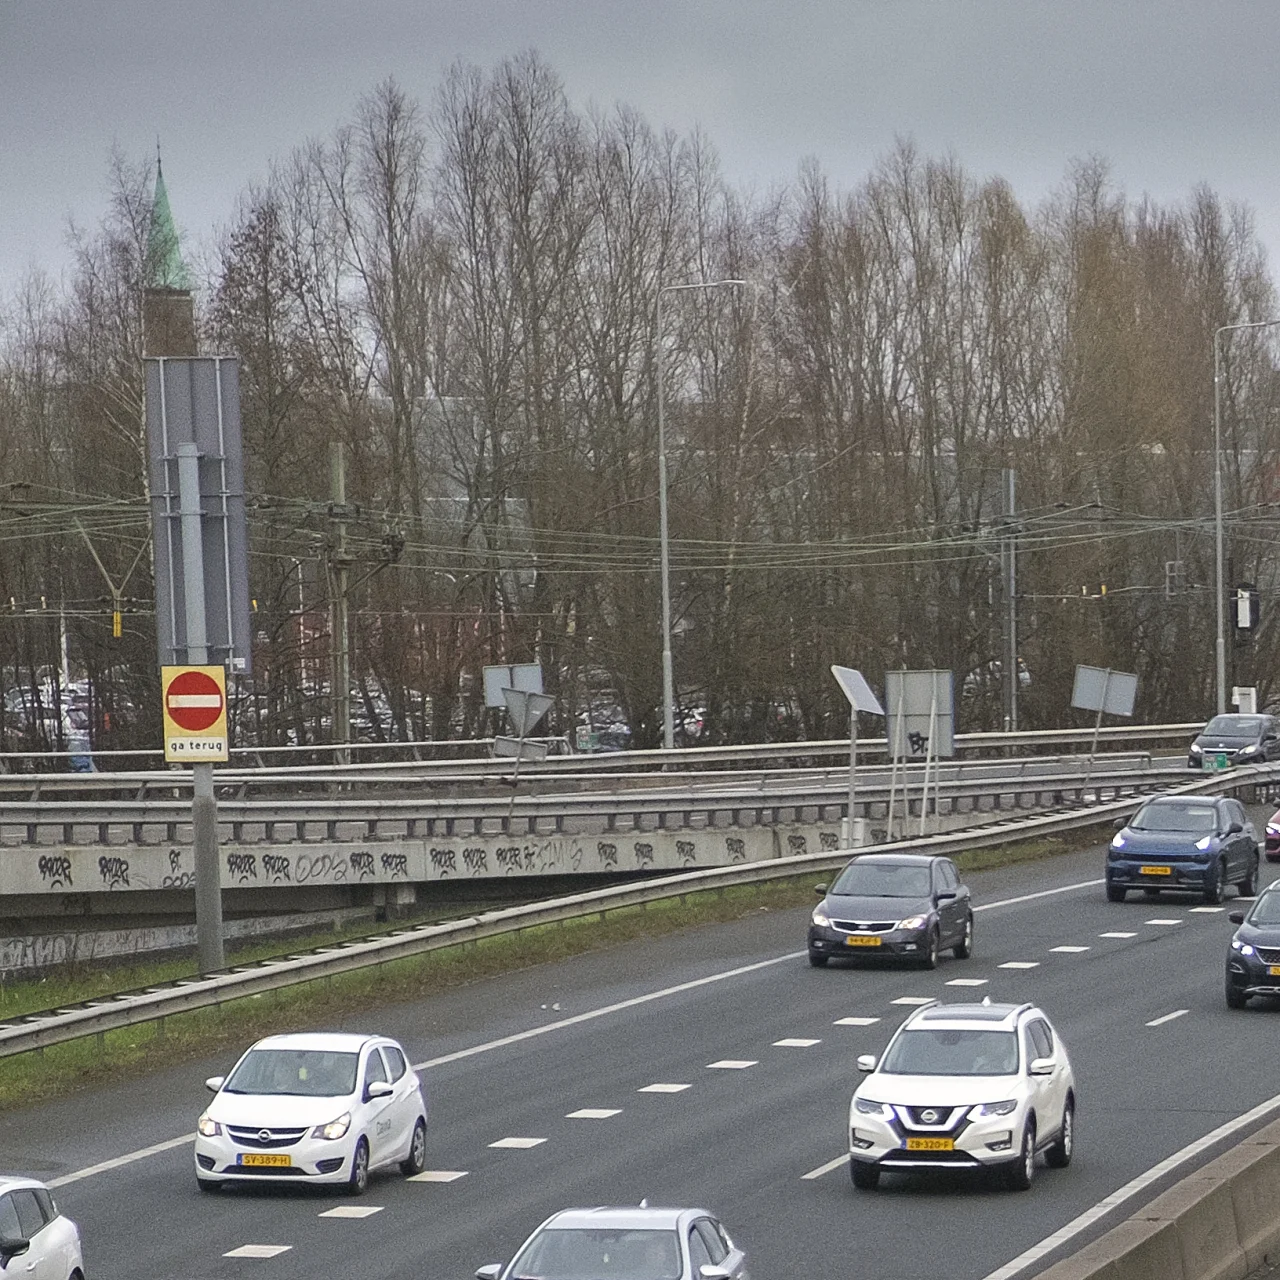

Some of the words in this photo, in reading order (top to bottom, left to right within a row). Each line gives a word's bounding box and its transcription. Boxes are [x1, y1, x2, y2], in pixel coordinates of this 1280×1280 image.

[171, 742, 184, 752] ga
[189, 741, 222, 752] terug
[243, 1155, 288, 1165] SV-389-H
